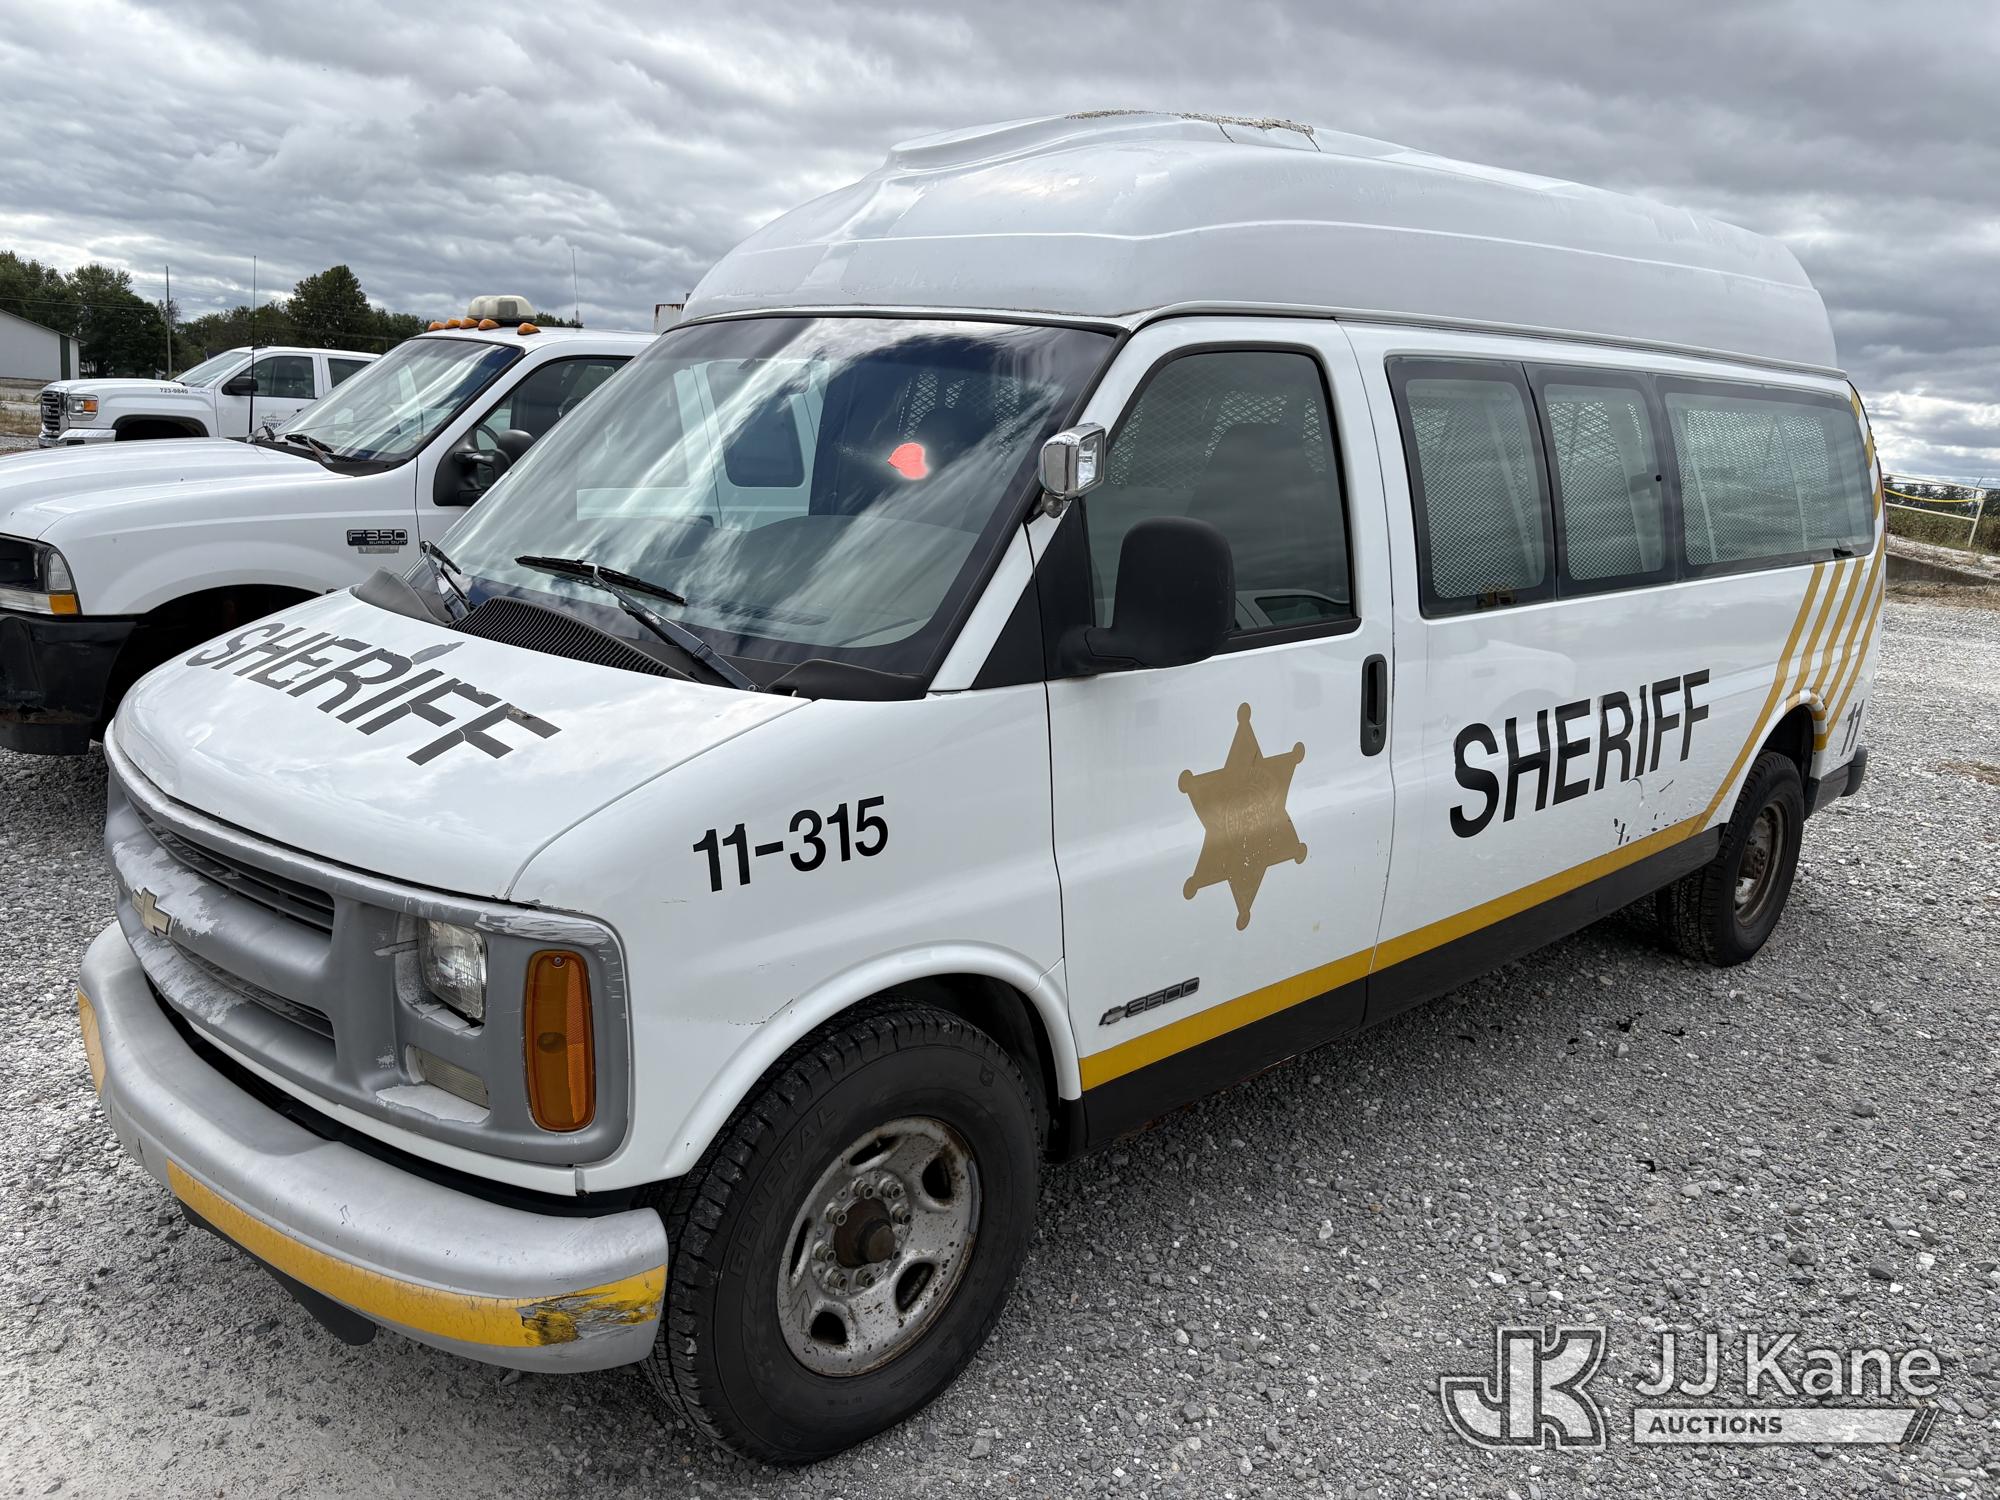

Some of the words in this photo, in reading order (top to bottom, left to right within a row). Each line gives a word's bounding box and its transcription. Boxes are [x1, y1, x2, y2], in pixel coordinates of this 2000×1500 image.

[186, 622, 562, 766] SHERIFF
[1450, 668, 1710, 838] SHERIFF
[693, 795, 889, 892] 11-315
[729, 1104, 838, 1278] GENERAL
